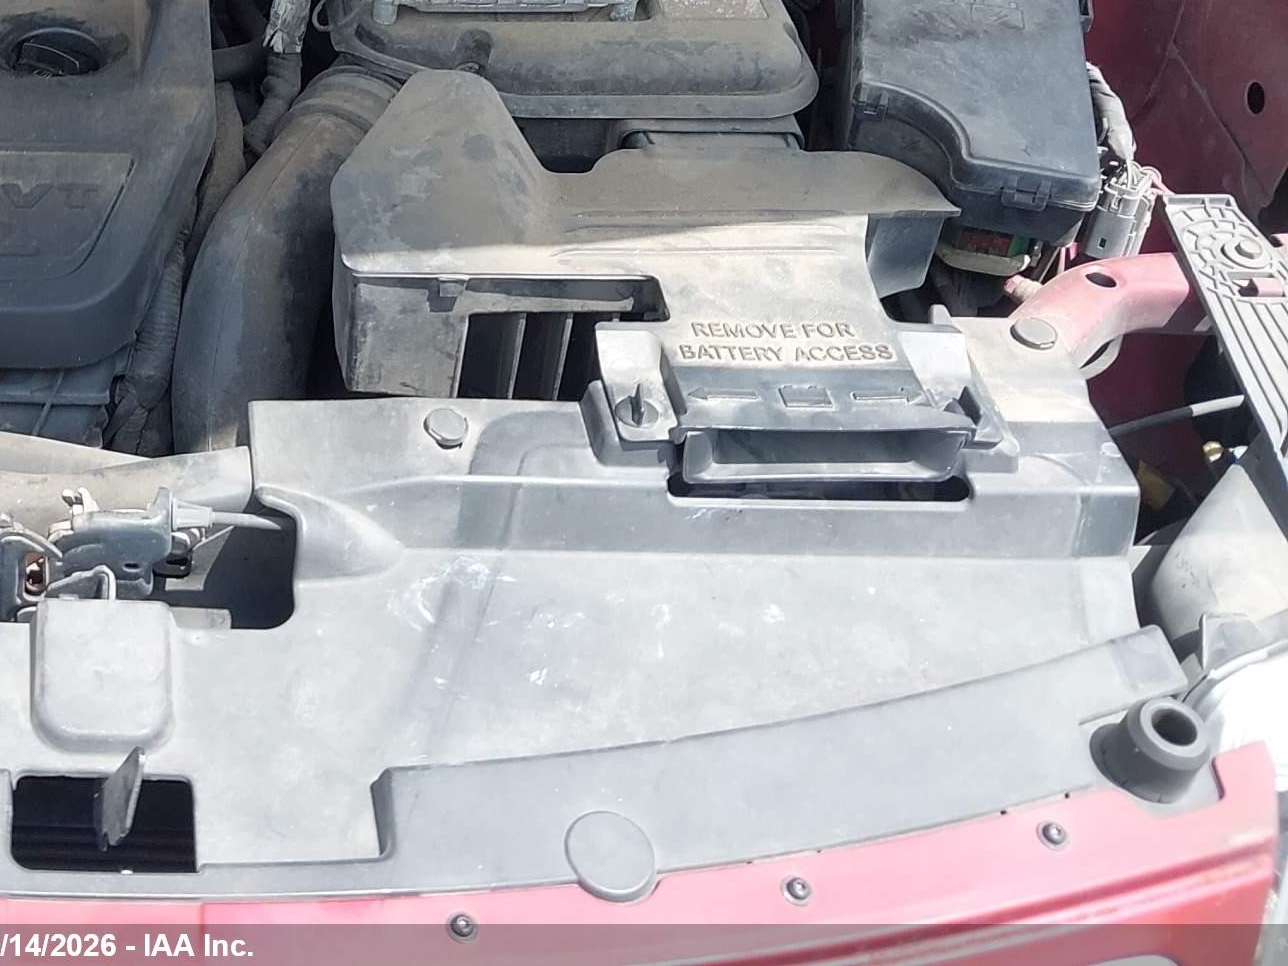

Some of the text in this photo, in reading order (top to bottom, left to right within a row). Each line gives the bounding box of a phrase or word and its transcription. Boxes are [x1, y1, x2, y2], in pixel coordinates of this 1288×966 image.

[691, 321, 857, 339] REMOVE FOR
[678, 344, 894, 362] BATTERY ACCESS
